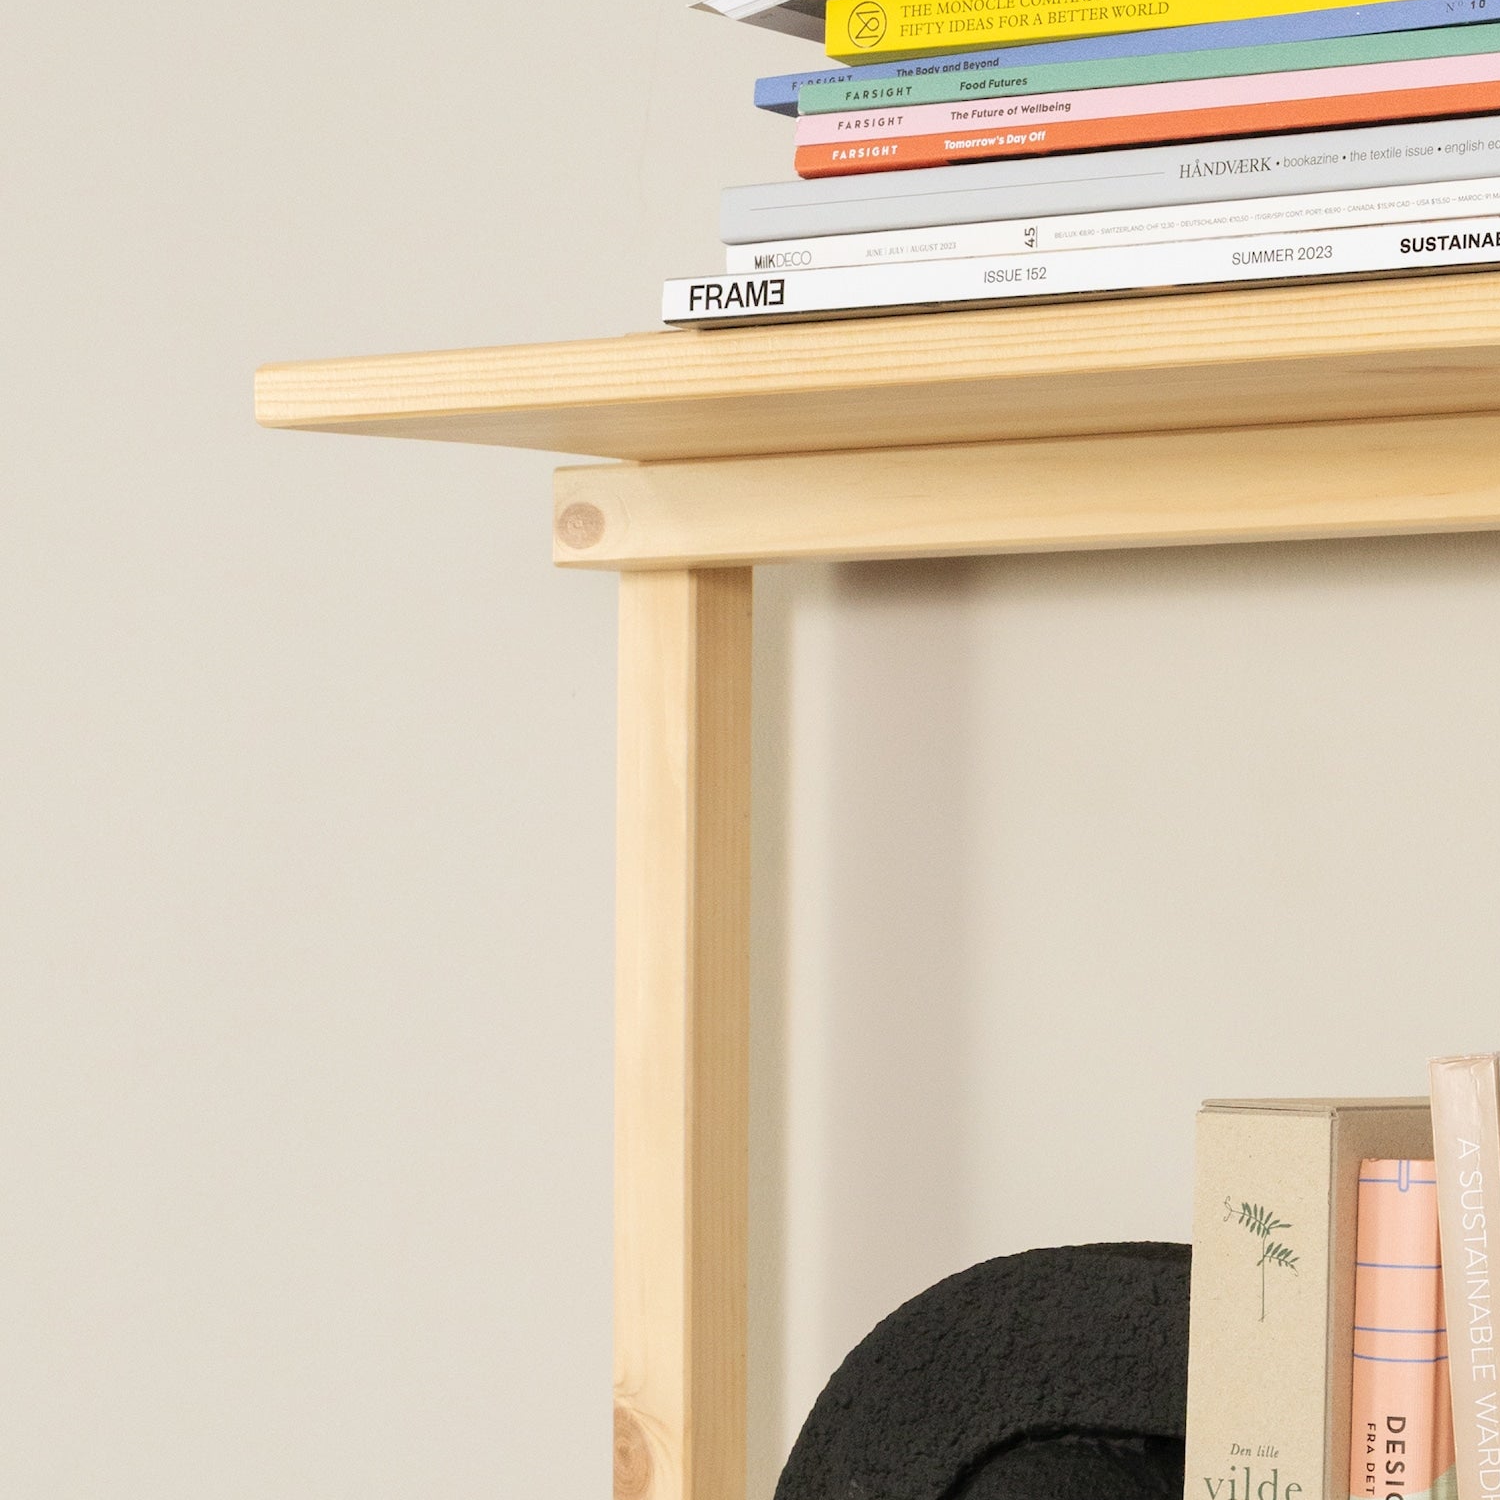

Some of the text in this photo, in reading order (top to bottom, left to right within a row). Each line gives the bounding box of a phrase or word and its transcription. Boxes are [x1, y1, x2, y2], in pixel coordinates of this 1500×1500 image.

[900, 1, 1170, 38] FIFTY IDEAS FOR A BETTER WORLD
[901, 4, 933, 19] THE
[896, 68, 913, 78] The
[943, 63, 961, 73] and
[963, 57, 1000, 71] Beyond
[1470, 0, 1486, 10] 10
[845, 86, 912, 101] FARSIGHT
[960, 79, 986, 91] Food
[988, 76, 1028, 89] Futures
[837, 116, 904, 130] FARSIGHT
[951, 111, 969, 120] The
[971, 107, 1004, 119] Future
[1007, 105, 1018, 116] of
[1021, 101, 1071, 114] Wellbeing
[832, 145, 899, 161] FARSIGHT
[944, 135, 1005, 150] Tomorrow's
[1006, 133, 1027, 146] Day
[1029, 130, 1046, 142] Off
[1178, 156, 1272, 180] HÅNDVÆRK
[1282, 151, 1339, 168] bookazine
[1349, 148, 1368, 162] the
[1370, 145, 1402, 161] textile
[1404, 144, 1434, 157] issue
[1443, 138, 1486, 155] english
[1417, 198, 1430, 206] USA
[910, 243, 938, 254] AUGUST
[939, 241, 957, 251] 2023
[1024, 227, 1036, 249] 45
[983, 268, 1022, 284] ISSUE
[1025, 267, 1047, 282] 152
[1232, 247, 1294, 266] SUMMER
[1297, 244, 1333, 261] 2023
[1458, 1137, 1481, 1160] A
[1459, 1171, 1497, 1382] SUSTAINABLE
[1230, 1443, 1280, 1458] Den lille
[1367, 1422, 1376, 1454] FRA
[1366, 1463, 1376, 1495] DET
